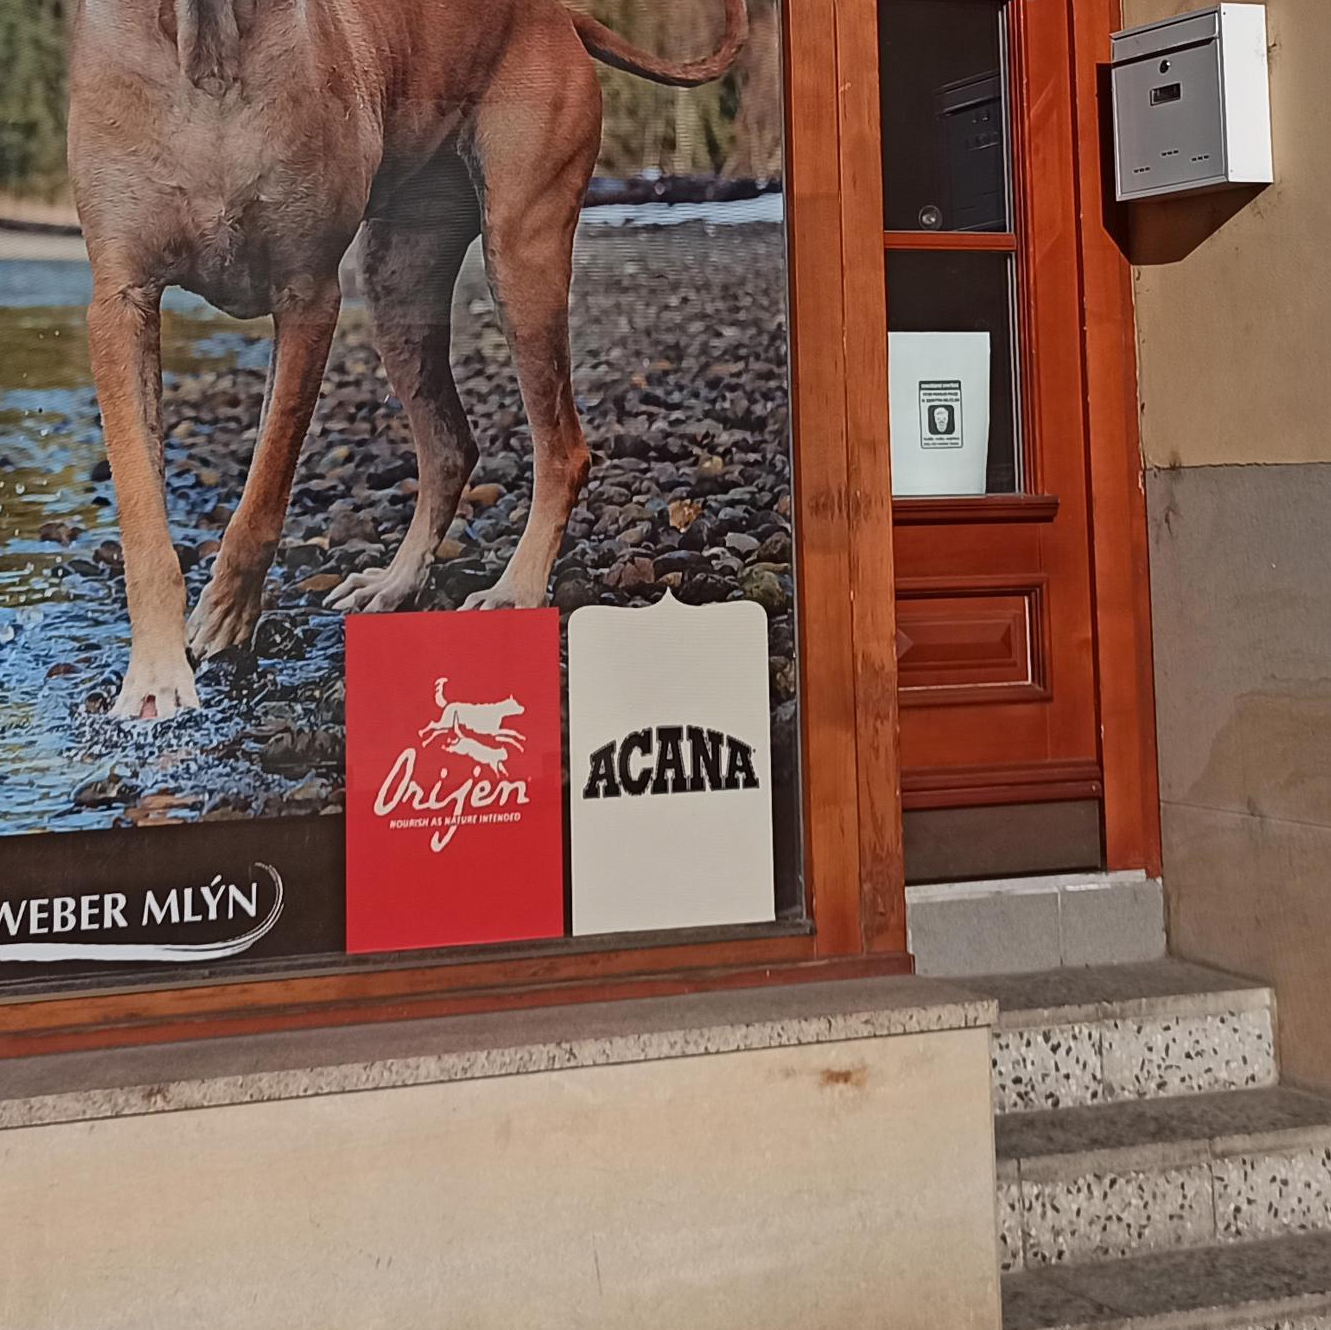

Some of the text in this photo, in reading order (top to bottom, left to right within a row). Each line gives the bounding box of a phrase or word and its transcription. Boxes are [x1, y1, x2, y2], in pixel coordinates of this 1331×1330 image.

[582, 725, 761, 800] ACANA
[373, 748, 531, 853] Orijen
[390, 817, 429, 829] NOURISH
[431, 816, 443, 827] AS
[479, 812, 521, 824] INTENDED
[141, 875, 258, 926] MLÝN
